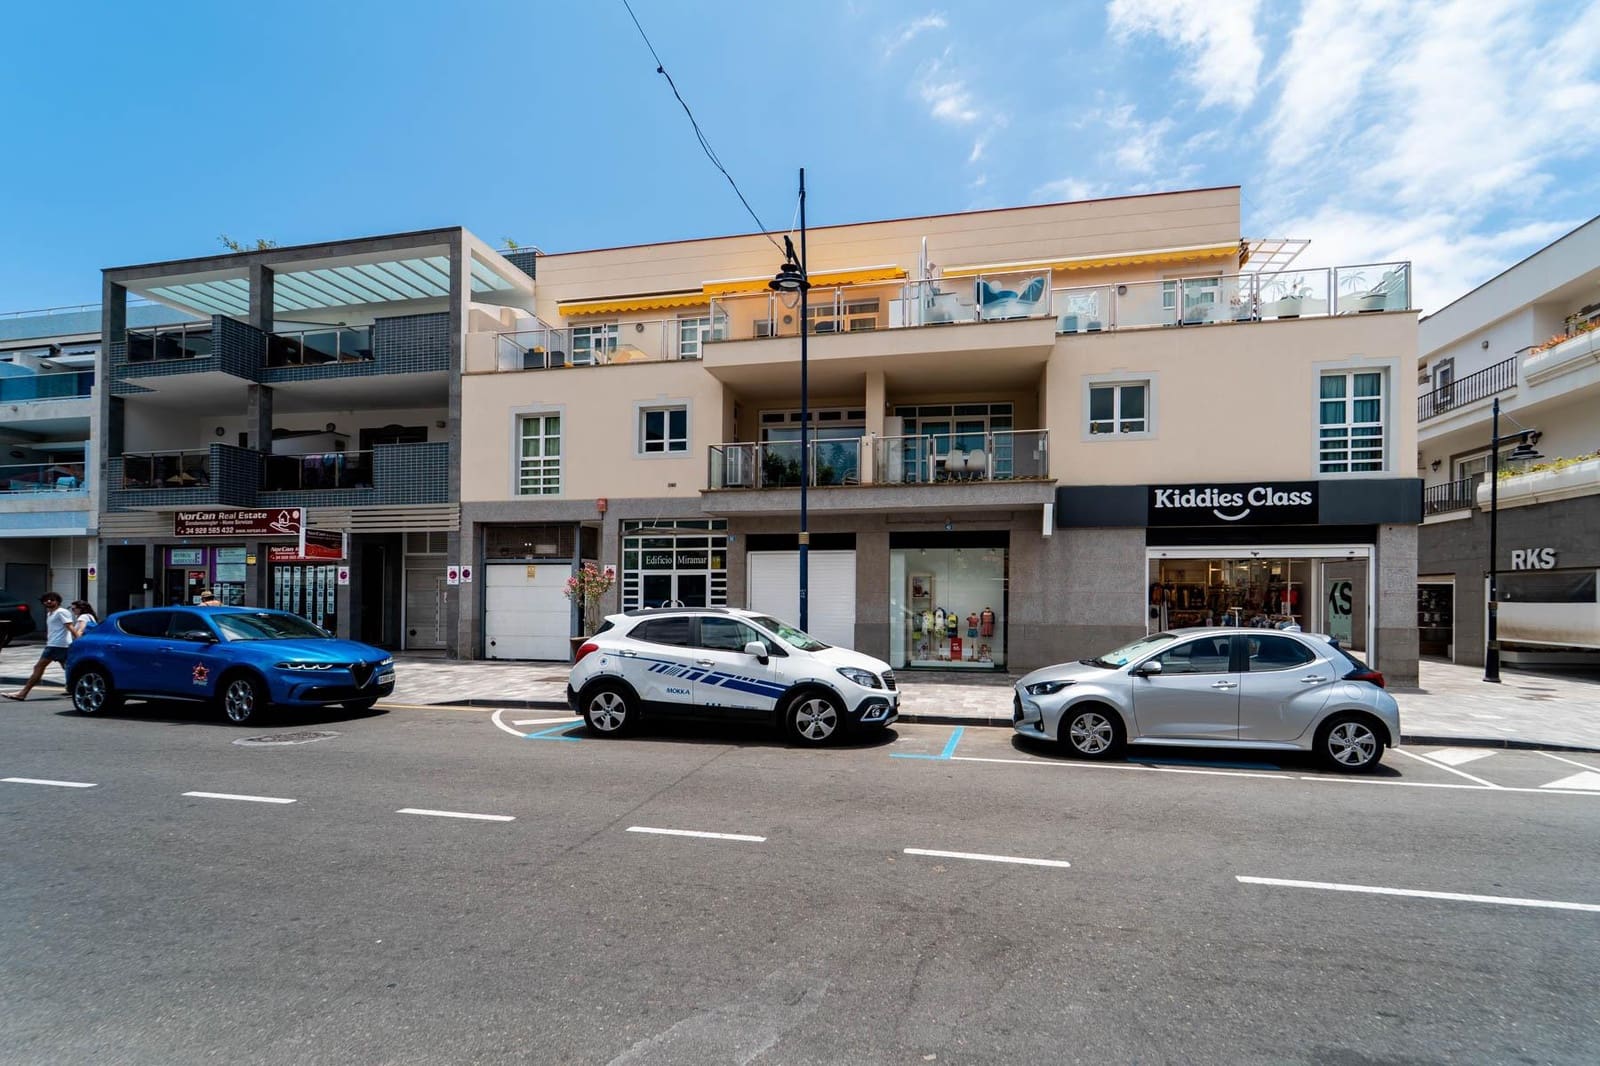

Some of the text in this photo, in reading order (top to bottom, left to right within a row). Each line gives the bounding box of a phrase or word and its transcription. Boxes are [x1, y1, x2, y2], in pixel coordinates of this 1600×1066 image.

[1154, 487, 1312, 508] Kiddies Class
[178, 511, 267, 521] NorCan Real Estate
[646, 555, 673, 565] Edificio
[677, 555, 707, 564] Miramar
[1511, 547, 1555, 570] RKS
[666, 687, 690, 695] MOKKA
